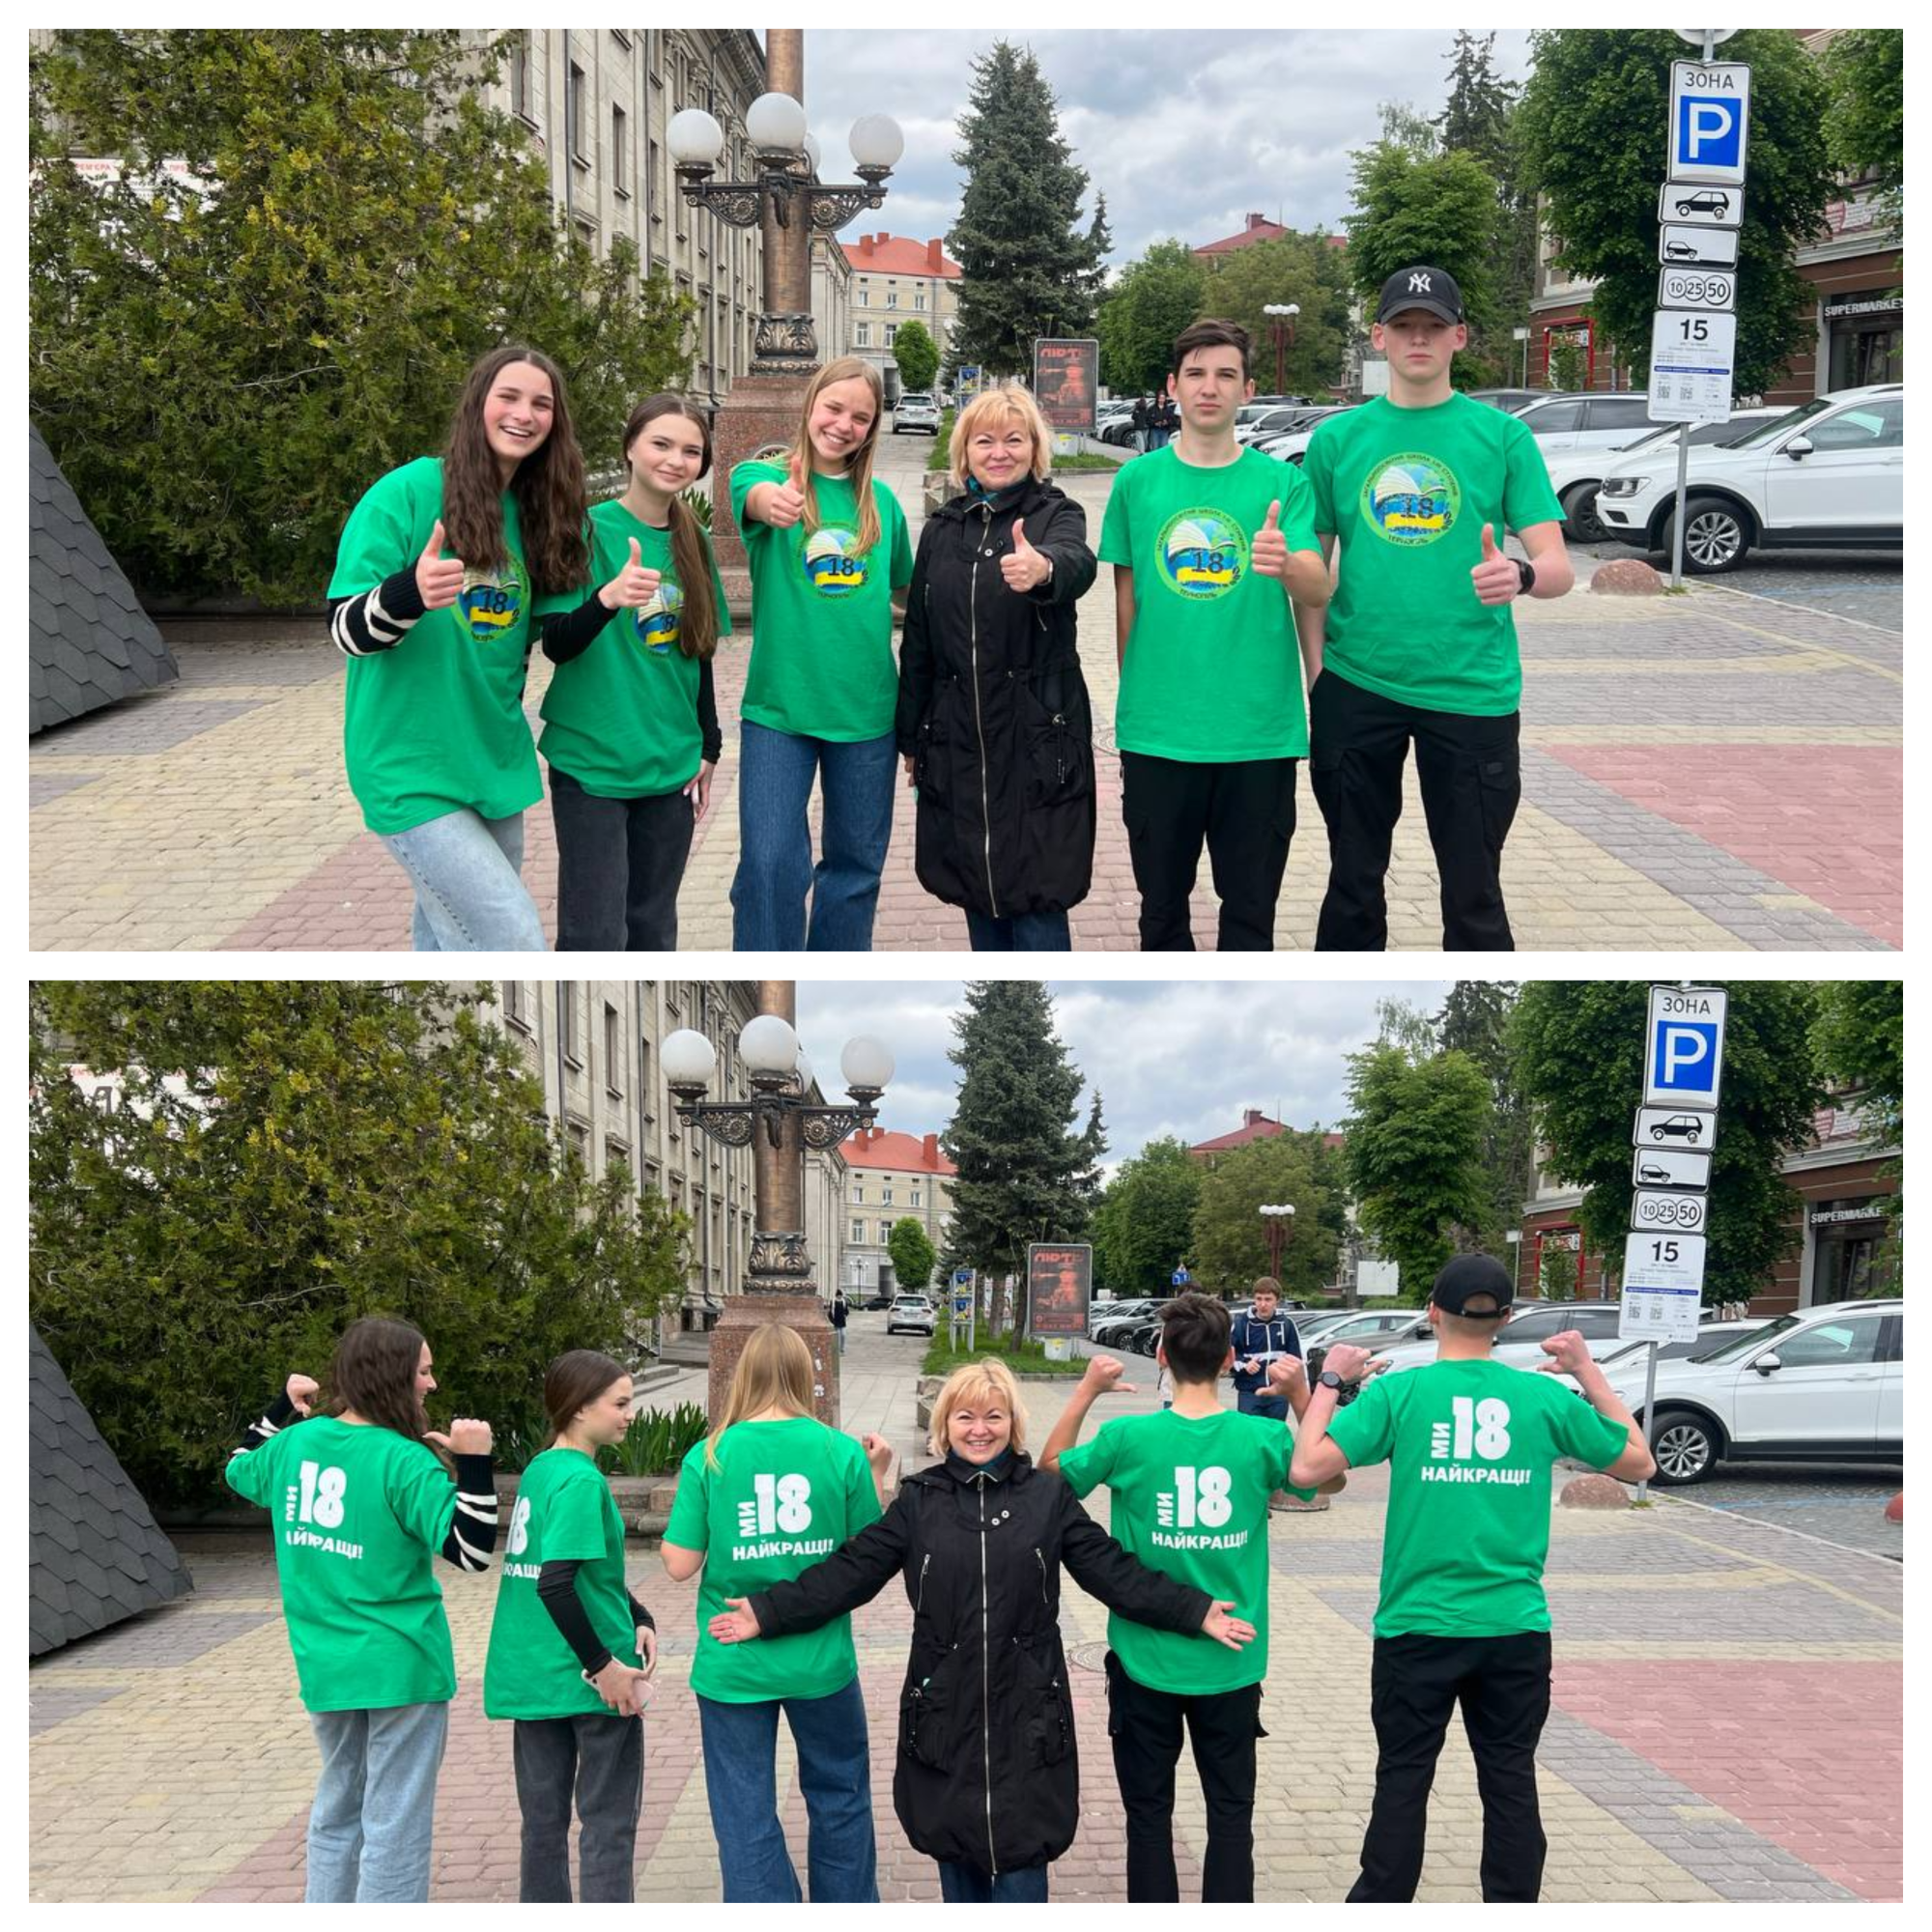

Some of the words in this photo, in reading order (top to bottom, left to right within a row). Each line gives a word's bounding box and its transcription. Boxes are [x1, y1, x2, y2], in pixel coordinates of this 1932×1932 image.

[1685, 71, 1734, 89] ЗОНА
[1689, 101, 1732, 158] P
[1408, 272, 1432, 293] NY
[1670, 282, 1683, 293] 10
[1687, 282, 1703, 295] 25
[1707, 283, 1726, 298] 50
[1824, 298, 1903, 317] SUPERMARKE
[1680, 319, 1708, 340] 15
[1400, 496, 1435, 520] 18
[827, 557, 854, 577] 18
[1191, 552, 1224, 574] 18
[478, 589, 508, 615] 18
[1662, 997, 1710, 1014] ЗОНА
[1664, 1028, 1707, 1083] P
[1643, 1205, 1656, 1215] 10
[1659, 1206, 1674, 1217] 25
[1679, 1206, 1697, 1220] 50
[1810, 1207, 1885, 1224] SUPERMARKE
[1652, 1240, 1679, 1262] 15
[1452, 1396, 1511, 1461] 18
[1431, 1423, 1450, 1459] МИ
[1421, 1463, 1531, 1486] НАЙКРАЩІ!
[287, 1486, 298, 1521] МИ
[298, 1460, 347, 1528] 18
[754, 1473, 811, 1534] 18
[1175, 1465, 1232, 1527] 18
[737, 1501, 756, 1537] МИ
[1156, 1492, 1173, 1526] МИ
[732, 1539, 834, 1561] НАЙКРАЩІ!
[1151, 1530, 1248, 1549] НАЙКРАЩІ!
